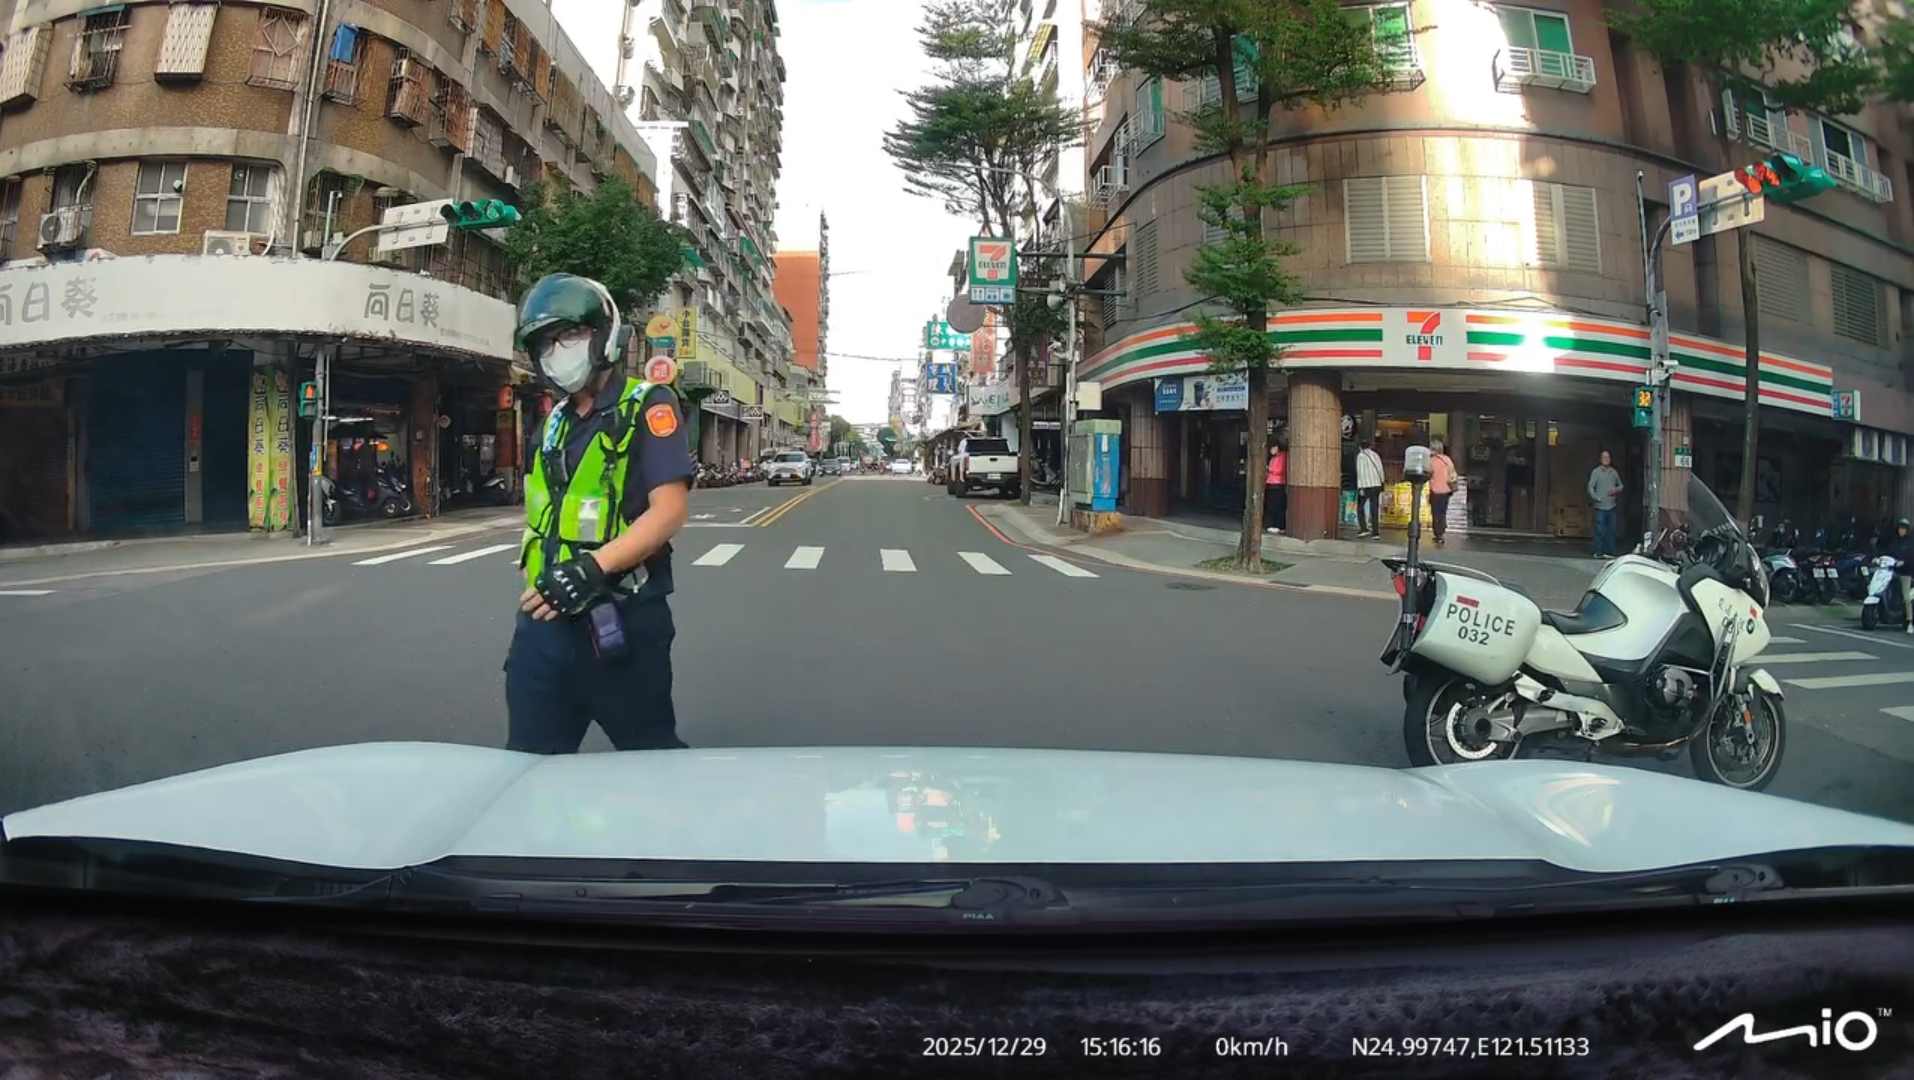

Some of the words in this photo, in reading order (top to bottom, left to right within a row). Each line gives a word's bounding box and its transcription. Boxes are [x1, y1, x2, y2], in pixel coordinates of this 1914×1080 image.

[1673, 183, 1692, 216] P
[363, 283, 440, 328] 向日葵
[1446, 603, 1516, 636] POLICE
[1458, 626, 1490, 646] 032
